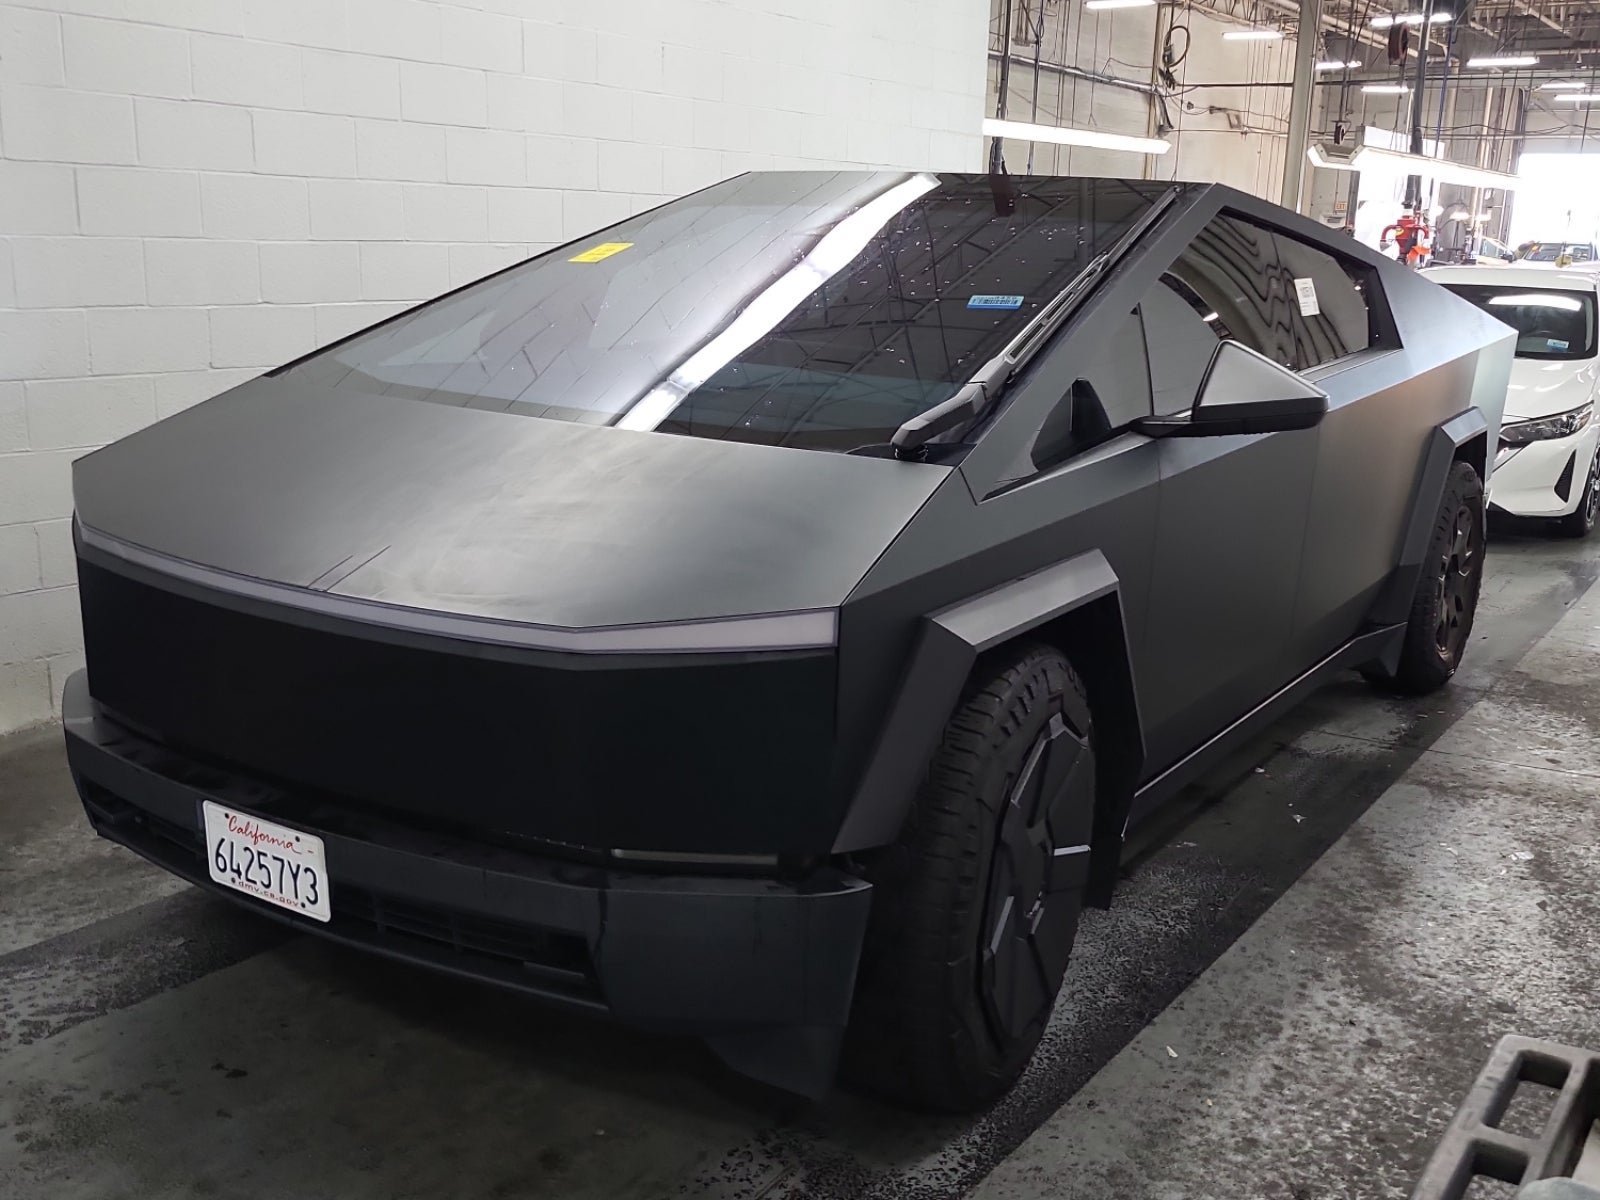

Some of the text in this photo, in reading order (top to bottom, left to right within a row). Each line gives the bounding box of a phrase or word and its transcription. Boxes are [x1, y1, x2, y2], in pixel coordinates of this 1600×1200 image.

[228, 815, 302, 854] California
[215, 837, 319, 905] 64257Y3
[239, 880, 299, 907] dmv.ca.gov
